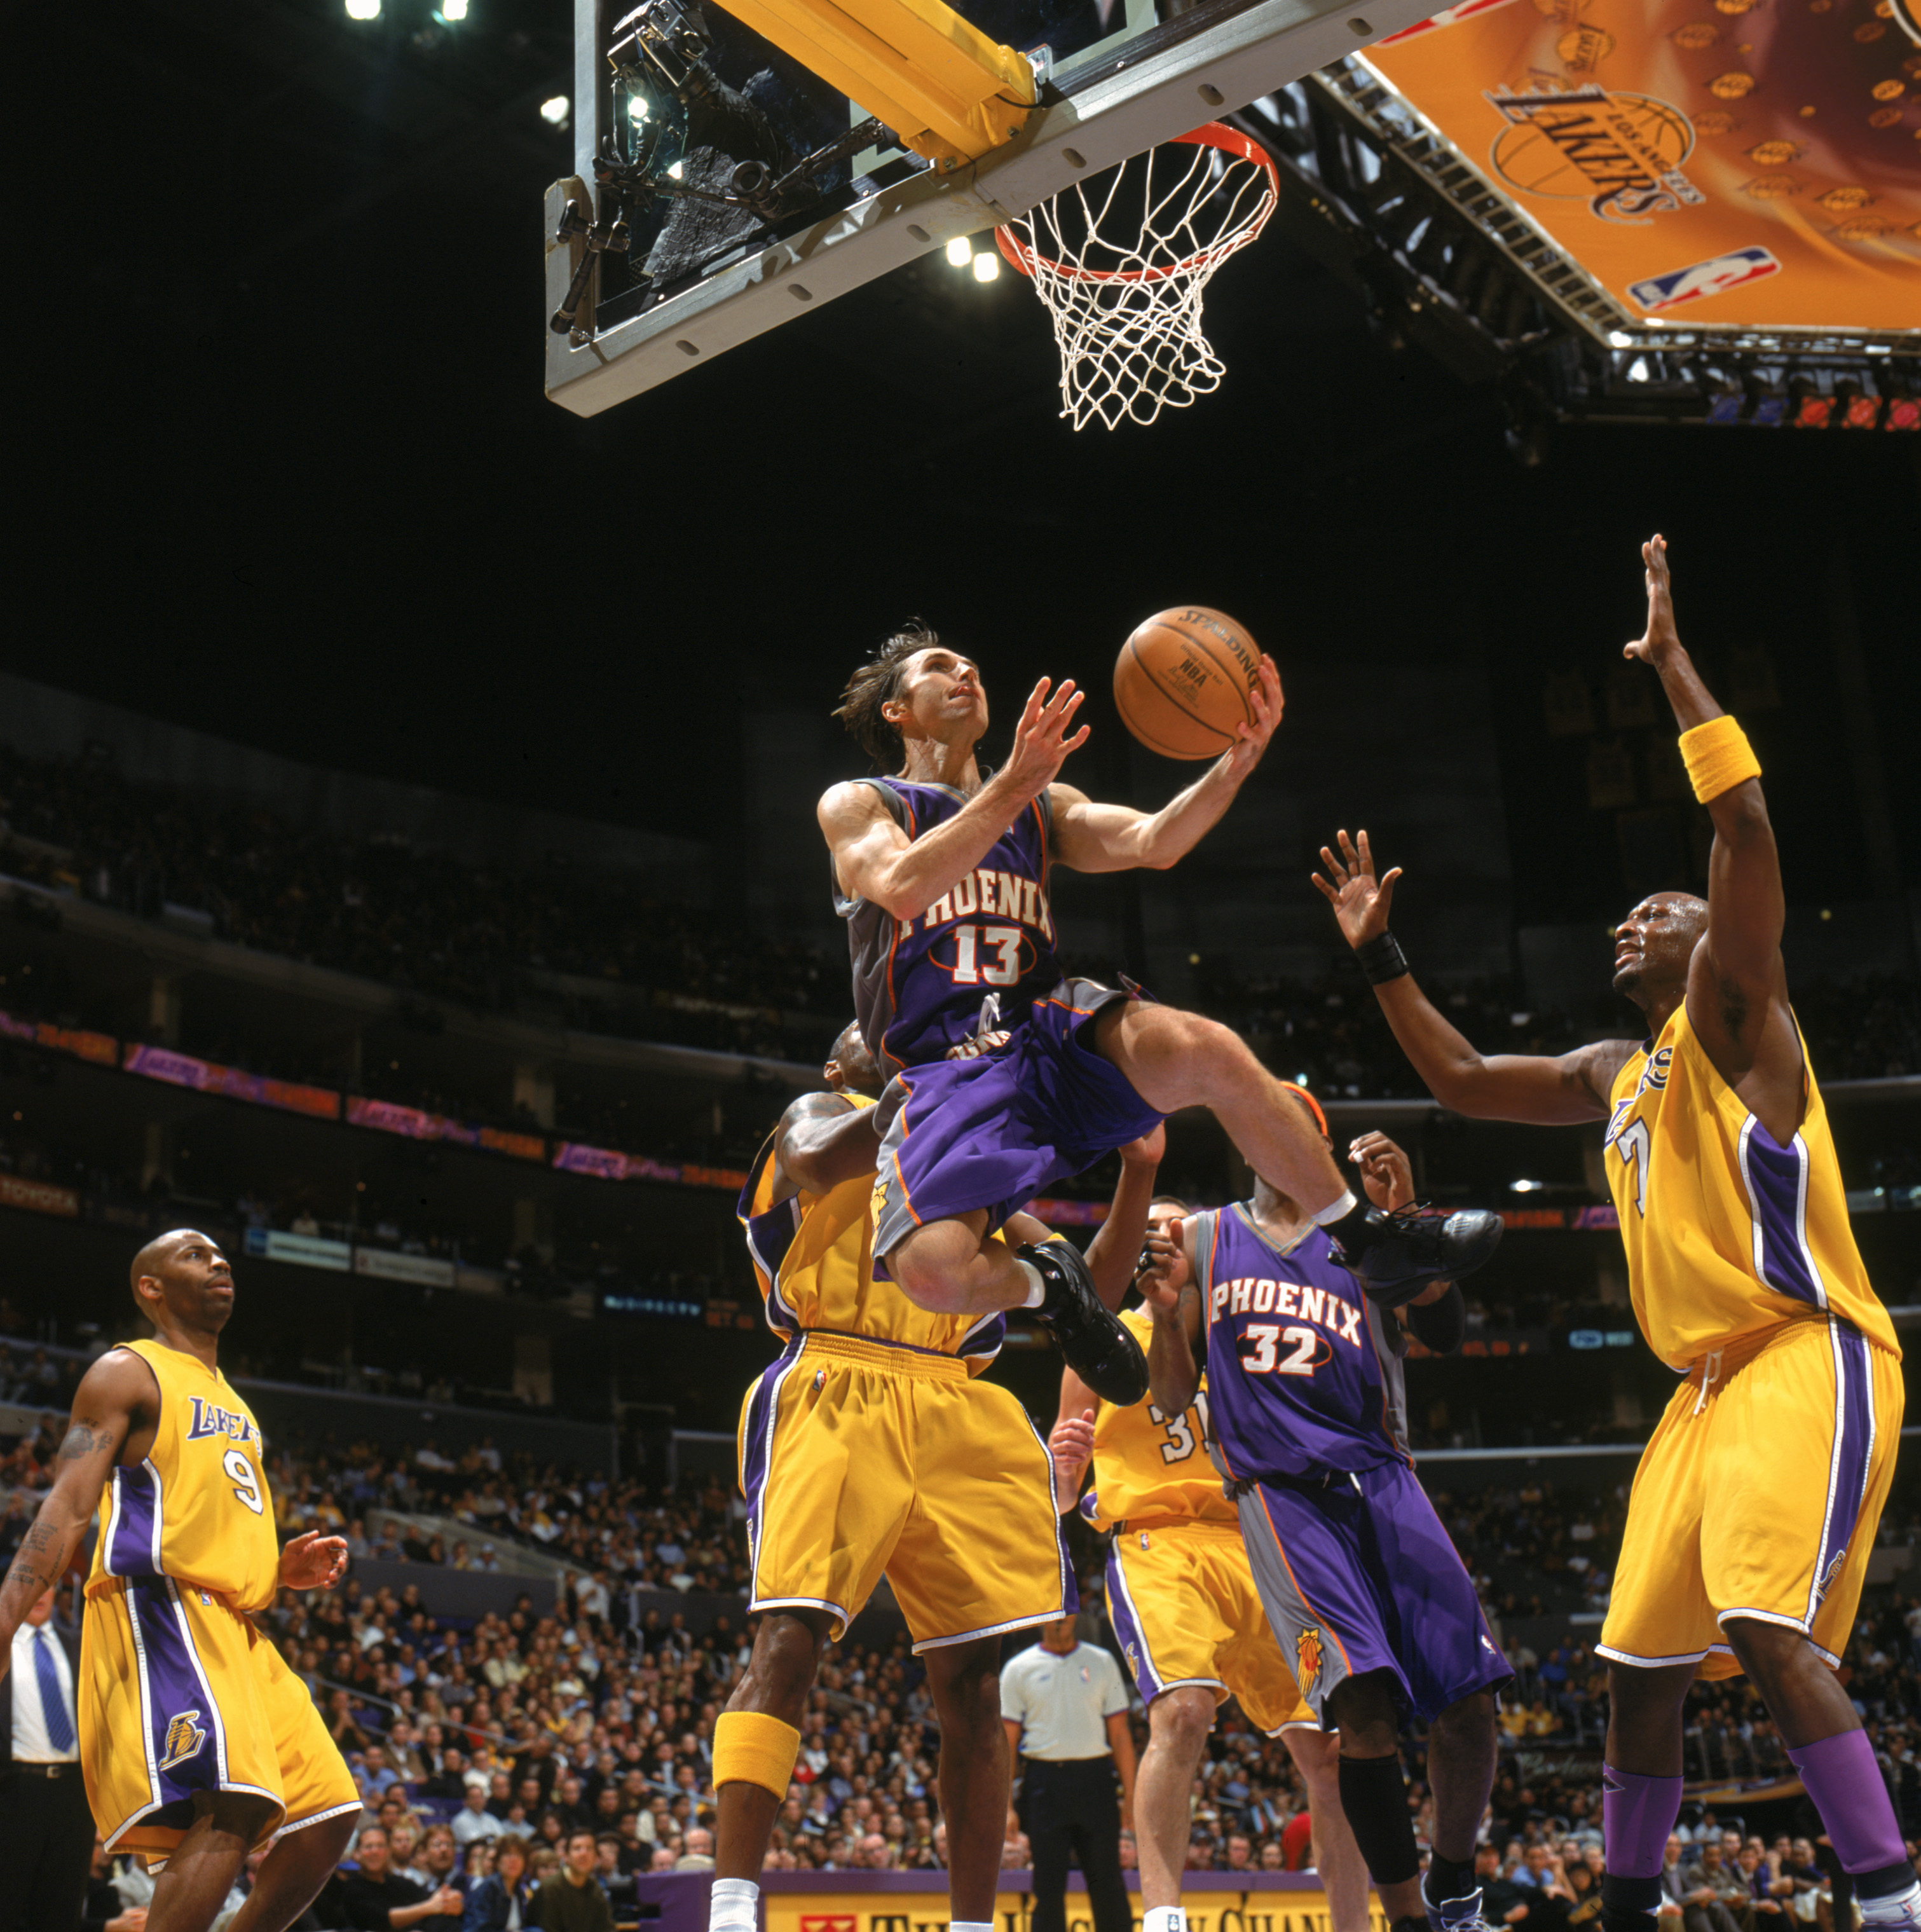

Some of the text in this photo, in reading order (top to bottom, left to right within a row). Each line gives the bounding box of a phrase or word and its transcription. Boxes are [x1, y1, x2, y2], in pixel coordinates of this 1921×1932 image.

[1482, 83, 1680, 225] LAKERS
[1606, 113, 1644, 140] LOS
[1178, 610, 1260, 689] SPALDING
[1179, 659, 1207, 687] NBA
[952, 924, 1023, 987] 13
[1, 1180, 78, 1212] TOYOTA
[1615, 1115, 1651, 1219] 7
[1211, 1277, 1362, 1349] PHOENIX
[1242, 1322, 1315, 1377] 32
[222, 1448, 264, 1516] 9
